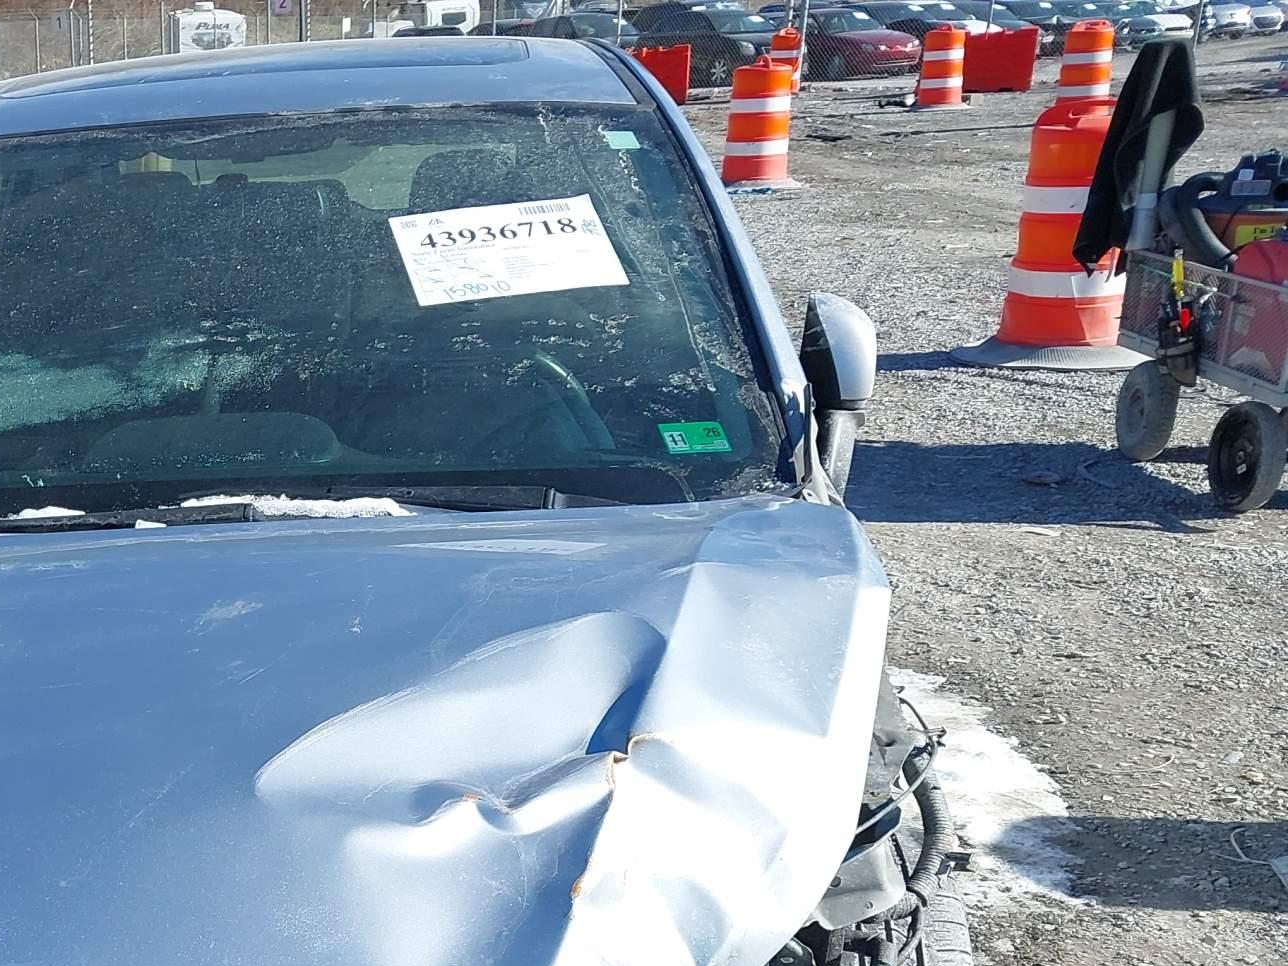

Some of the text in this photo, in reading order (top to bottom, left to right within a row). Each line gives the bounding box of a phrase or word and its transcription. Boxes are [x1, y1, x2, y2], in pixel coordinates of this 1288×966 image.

[55, 15, 62, 30] 1
[420, 217, 578, 249] 43936718
[702, 426, 721, 438] 26
[667, 433, 688, 446] 11
